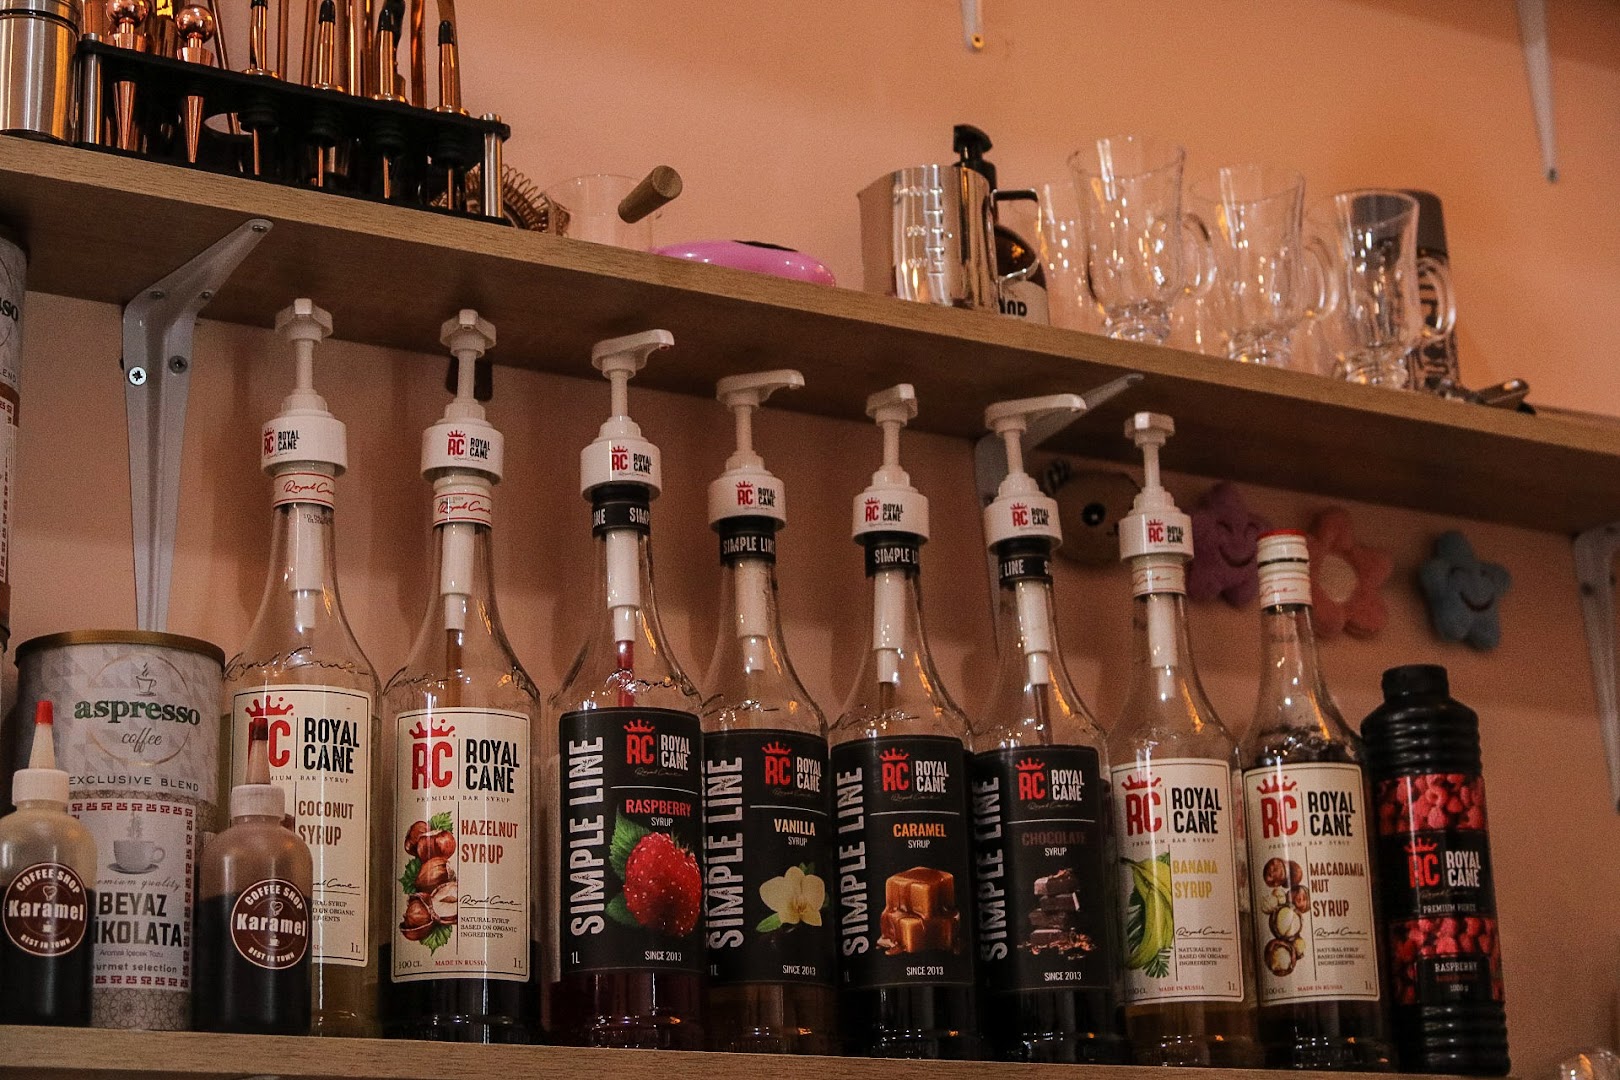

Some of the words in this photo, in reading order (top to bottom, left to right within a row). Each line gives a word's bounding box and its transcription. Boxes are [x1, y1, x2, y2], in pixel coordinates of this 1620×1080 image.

[278, 430, 300, 441] ROYAL
[470, 437, 491, 450] ROYAL
[278, 440, 298, 451] CANE
[447, 438, 465, 456] RC
[469, 447, 488, 460] CANE
[611, 454, 628, 471] RC
[633, 453, 652, 466] ROYAL
[634, 462, 651, 475] CANE
[737, 489, 753, 505] RC
[758, 487, 776, 499] ROYAL
[758, 497, 775, 507] CANE
[882, 504, 904, 513] ROYAL
[865, 505, 879, 522] RC
[882, 512, 901, 522] CANE
[1012, 510, 1028, 527] RC
[1031, 508, 1049, 518] ROYAL
[1032, 516, 1049, 526] CANE
[1148, 527, 1164, 543] RC
[1167, 526, 1184, 536] ROYAL
[1167, 534, 1184, 544] CANE
[722, 536, 757, 555] SIMPLE
[874, 548, 910, 564] SIMPLE
[1004, 559, 1025, 577] LINE
[74, 700, 200, 725] aspresso
[122, 728, 162, 753] coffee
[304, 717, 360, 748] ROYAL
[466, 738, 520, 768] ROYAL
[626, 734, 655, 765] RC
[660, 734, 691, 755] ROYAL
[303, 744, 354, 774] CANE
[412, 741, 453, 790] RC
[661, 751, 689, 771] CANE
[796, 757, 822, 776] ROYAL
[569, 737, 604, 806] LINE
[765, 756, 791, 786] RC
[882, 762, 909, 792] RC
[915, 760, 949, 778] ROYAL
[1051, 769, 1085, 786] ROYAL
[69, 775, 152, 785] EXCLUSIVE
[160, 778, 199, 792] BLEND
[324, 776, 349, 784] SYRUP
[465, 764, 515, 794] CANE
[796, 773, 820, 793] CANE
[916, 776, 947, 793] CANE
[1018, 772, 1046, 800] RC
[707, 757, 743, 823] LINE
[1052, 784, 1083, 801] CANE
[416, 795, 455, 803] PREMIUM
[837, 767, 864, 834] LINE
[1171, 787, 1222, 811] ROYAL
[1307, 791, 1356, 814] ROYAL
[298, 800, 354, 820] COCONUT
[625, 799, 691, 817] RASPBERRY
[972, 777, 1002, 840] LINE
[1125, 792, 1162, 837] RC
[1261, 794, 1298, 839] RC
[461, 820, 519, 839] HAZELNUT
[651, 817, 674, 827] SYRUP
[774, 818, 816, 836] VANILLA
[893, 823, 947, 838] CARAMEL
[1173, 810, 1218, 834] CANE
[1310, 814, 1353, 837] CANE
[299, 825, 342, 846] SYRUP
[788, 836, 807, 847] SYRUP
[908, 840, 931, 849] SYRUP
[1044, 847, 1067, 856] SYRUP
[461, 843, 504, 864] SYRUP
[1446, 851, 1481, 870] ROYAL
[570, 815, 605, 936] SIMPLE
[1173, 859, 1218, 875] BANANA
[1310, 862, 1365, 877] MACADAMIA
[1408, 854, 1440, 888] RC
[16, 869, 54, 892] COFFEE
[57, 871, 81, 894] SHOP
[1311, 879, 1330, 893] NUT
[1447, 868, 1480, 887] CANE
[244, 884, 281, 906] COFFEE
[282, 886, 303, 910] SHOP
[708, 833, 744, 949] SIMPLE
[1174, 881, 1213, 899] SYRUP
[99, 892, 167, 917] BEYAZ
[490, 895, 522, 905] Cane
[839, 841, 870, 957] SIMPLE
[977, 848, 1008, 962] SIMPLE
[8, 900, 85, 921] Karamel
[329, 908, 355, 916] ORGANIC
[1312, 900, 1350, 917] SYRUP
[1423, 903, 1456, 914] PREMIUM
[236, 913, 306, 937] Karamel
[20, 934, 39, 947] BEST
[40, 941, 49, 949] IN
[51, 937, 71, 949] TOWN
[350, 942, 361, 954] 1L
[248, 946, 265, 960] BEST
[267, 954, 275, 962] IN
[277, 952, 295, 962] TOWN
[571, 952, 580, 964] 1L
[645, 951, 665, 961] SINCE
[666, 952, 682, 962] 2013
[95, 962, 128, 971] urmet
[132, 963, 177, 973] selection
[514, 958, 523, 969] 1L
[782, 965, 801, 975] SINCE
[802, 966, 816, 976] 2013
[906, 966, 926, 976] SINCE
[927, 966, 944, 975] 2013
[1434, 962, 1478, 973] RASPBERRY
[1044, 972, 1064, 981] SINCE
[1065, 971, 1082, 980] 2013
